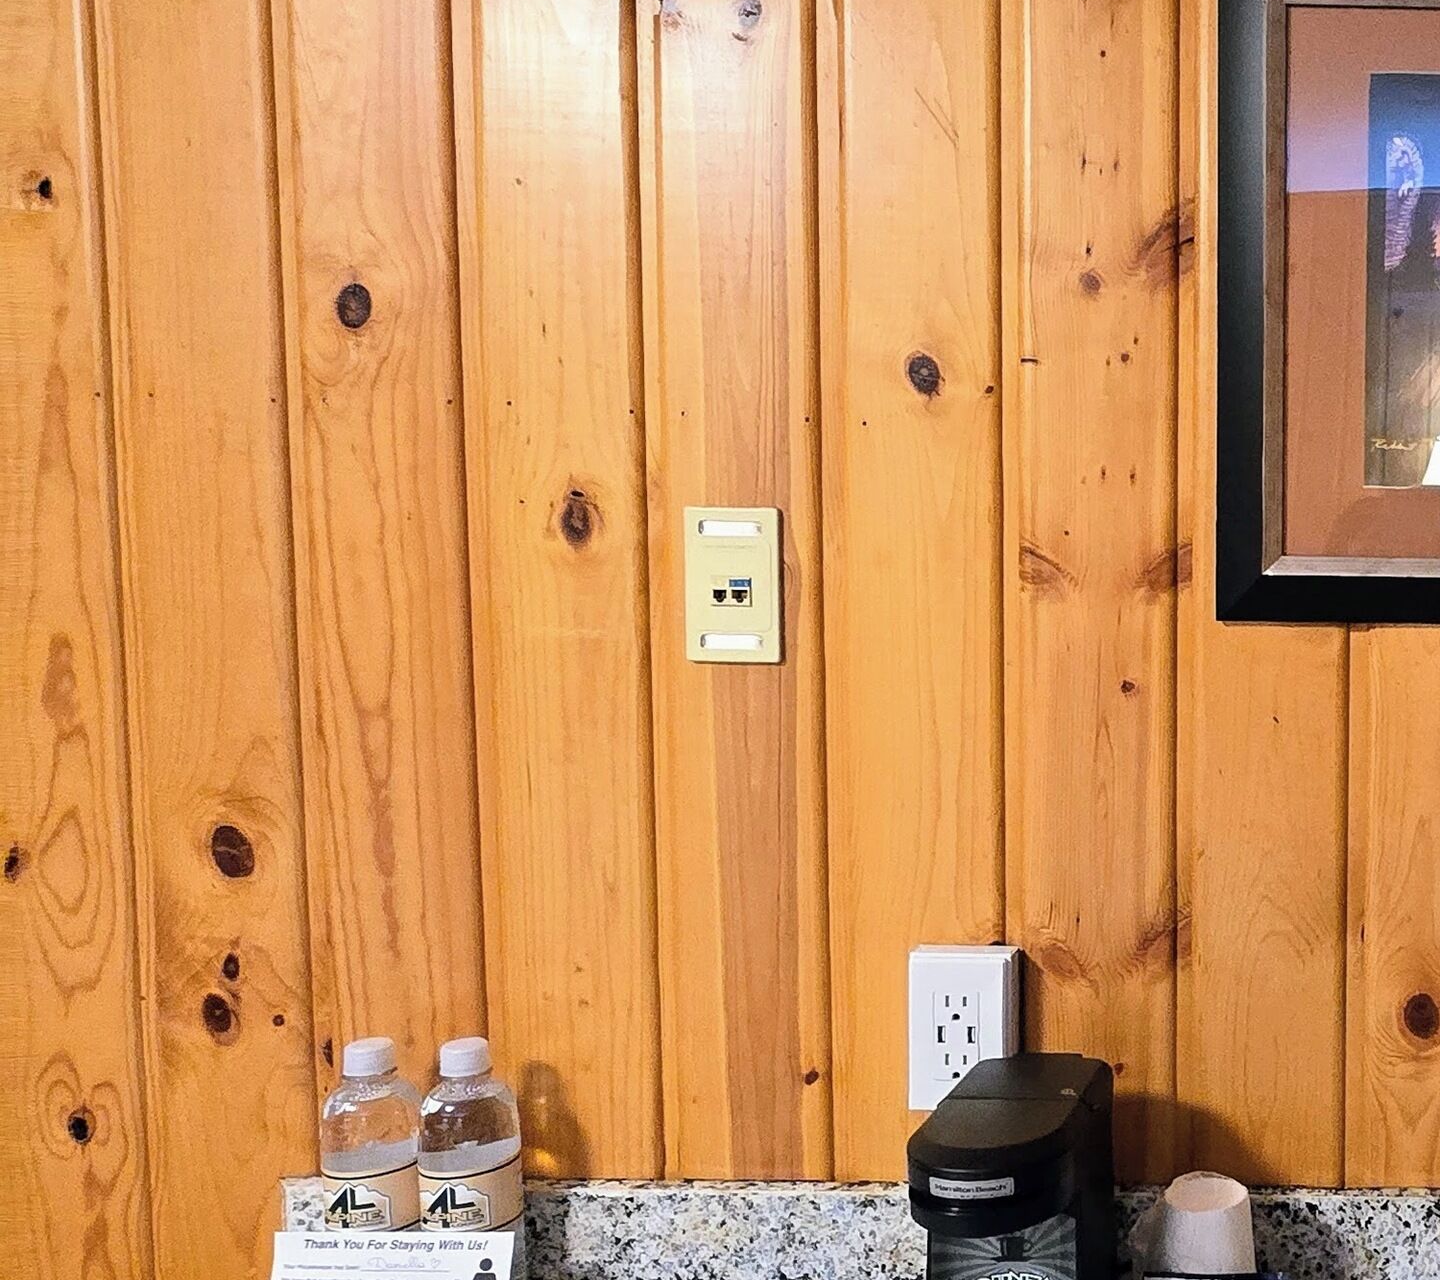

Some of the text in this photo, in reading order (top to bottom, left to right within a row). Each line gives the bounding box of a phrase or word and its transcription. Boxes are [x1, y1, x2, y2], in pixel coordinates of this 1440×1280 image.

[304, 1239, 488, 1252] Thank You For Staying With Us!
